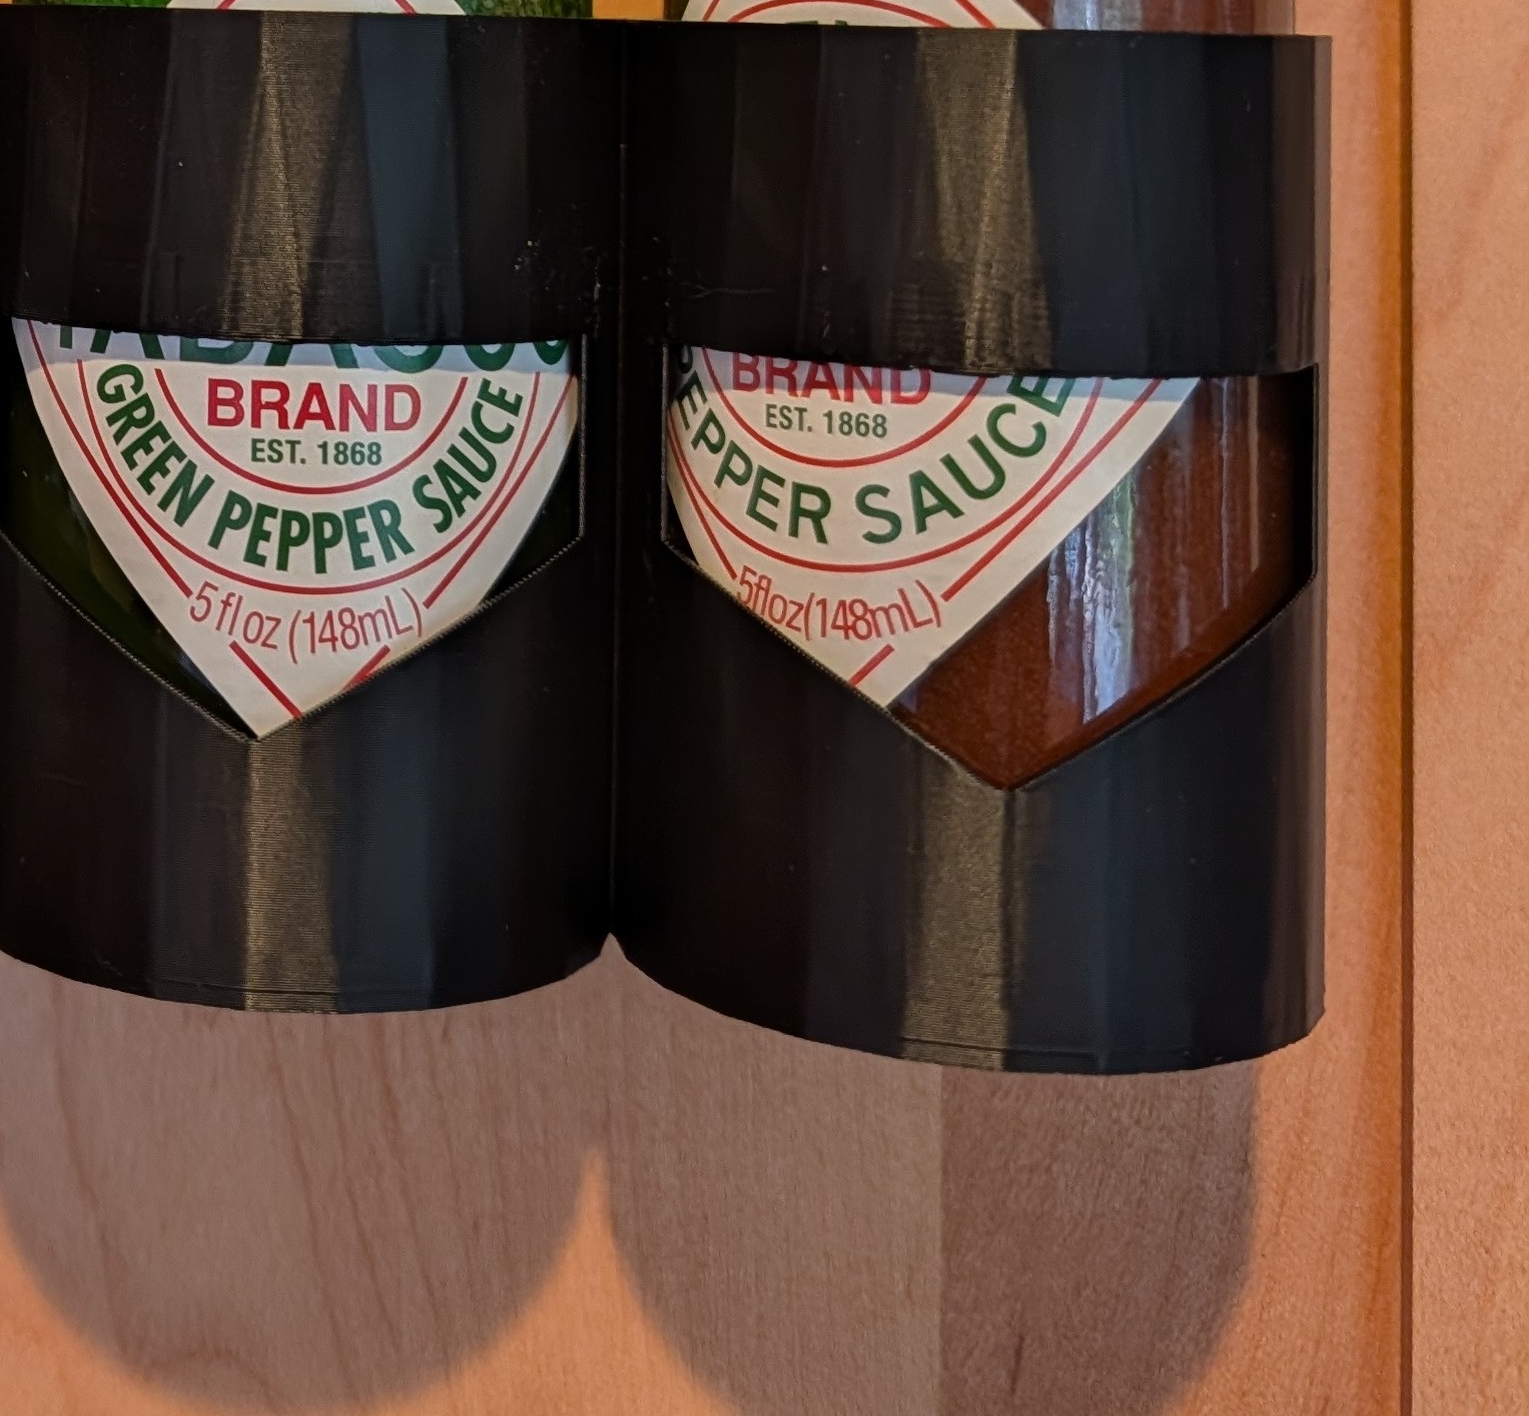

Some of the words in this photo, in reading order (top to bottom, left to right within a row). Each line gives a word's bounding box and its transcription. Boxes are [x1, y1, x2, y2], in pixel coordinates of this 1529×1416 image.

[206, 377, 423, 433] BRAND
[732, 352, 932, 406] BRAND
[764, 403, 813, 433] EST.
[822, 409, 889, 439] 1868
[95, 362, 216, 528] GREEN
[207, 489, 415, 575] PEPPER
[412, 377, 525, 535] SAUCE
[250, 437, 307, 466] EST.
[316, 440, 384, 467] 1868
[854, 373, 1076, 545] SAUCE
[188, 581, 215, 623] 5
[243, 609, 281, 651] oz
[288, 586, 425, 666] (148mL)
